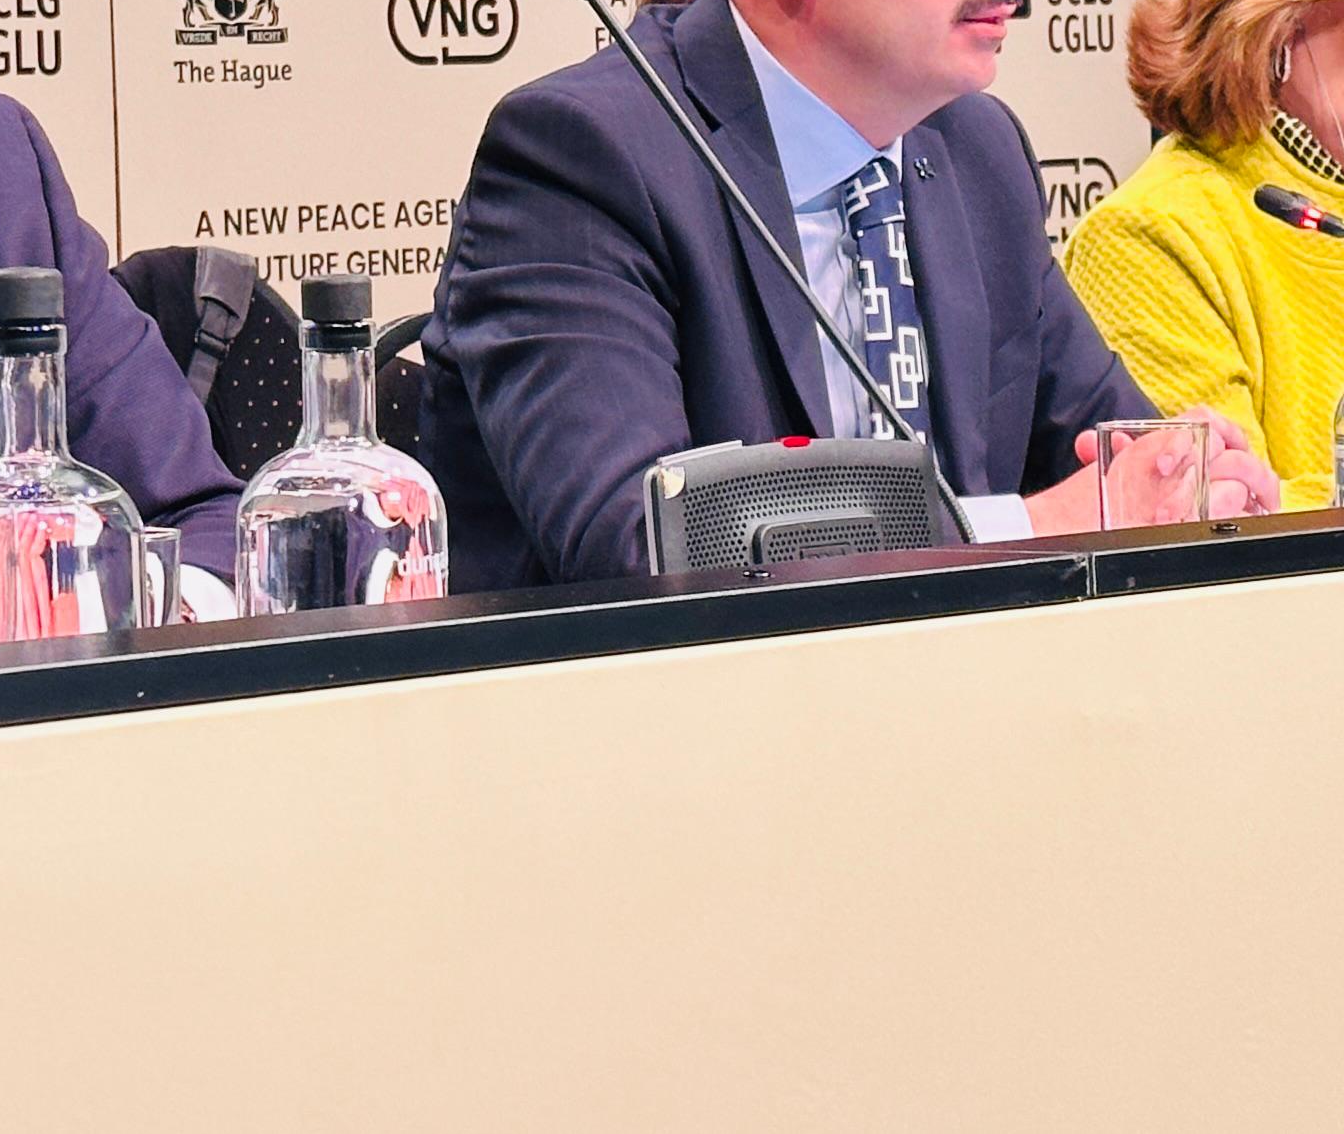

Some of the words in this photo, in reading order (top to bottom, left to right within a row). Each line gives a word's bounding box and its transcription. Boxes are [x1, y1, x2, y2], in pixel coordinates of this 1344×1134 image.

[1049, 14, 1113, 53] CGLU
[174, 60, 214, 83] The
[221, 60, 291, 89] Hague
[196, 211, 214, 237] A
[224, 207, 288, 236] NEW
[298, 202, 385, 233] PEACE
[395, 198, 459, 228] AGE
[255, 252, 340, 282] UTURE
[347, 247, 446, 278] GENERA
